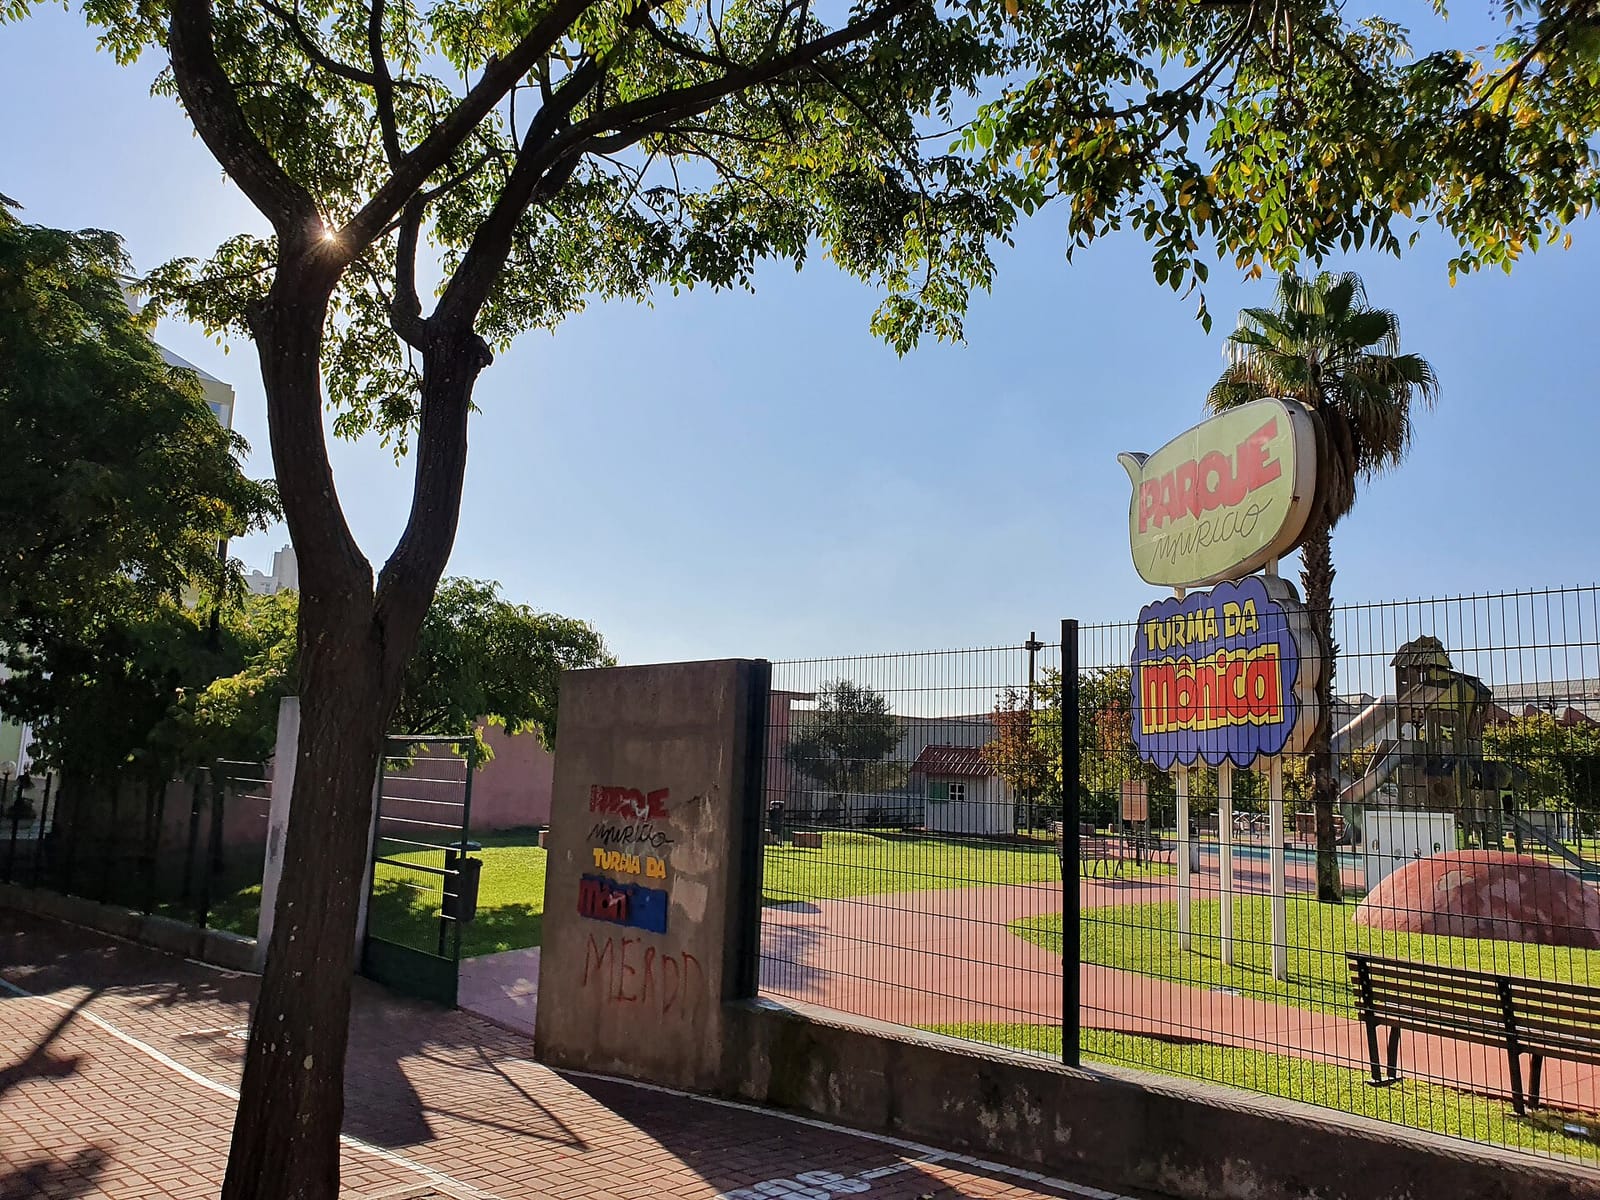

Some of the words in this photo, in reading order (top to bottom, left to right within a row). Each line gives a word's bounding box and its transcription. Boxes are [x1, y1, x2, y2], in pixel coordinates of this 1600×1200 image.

[1138, 415, 1282, 533] PARQUE
[1144, 607, 1218, 651] TURMA
[1223, 598, 1259, 638] DA
[592, 847, 641, 875] TURMA
[646, 855, 667, 880] DA
